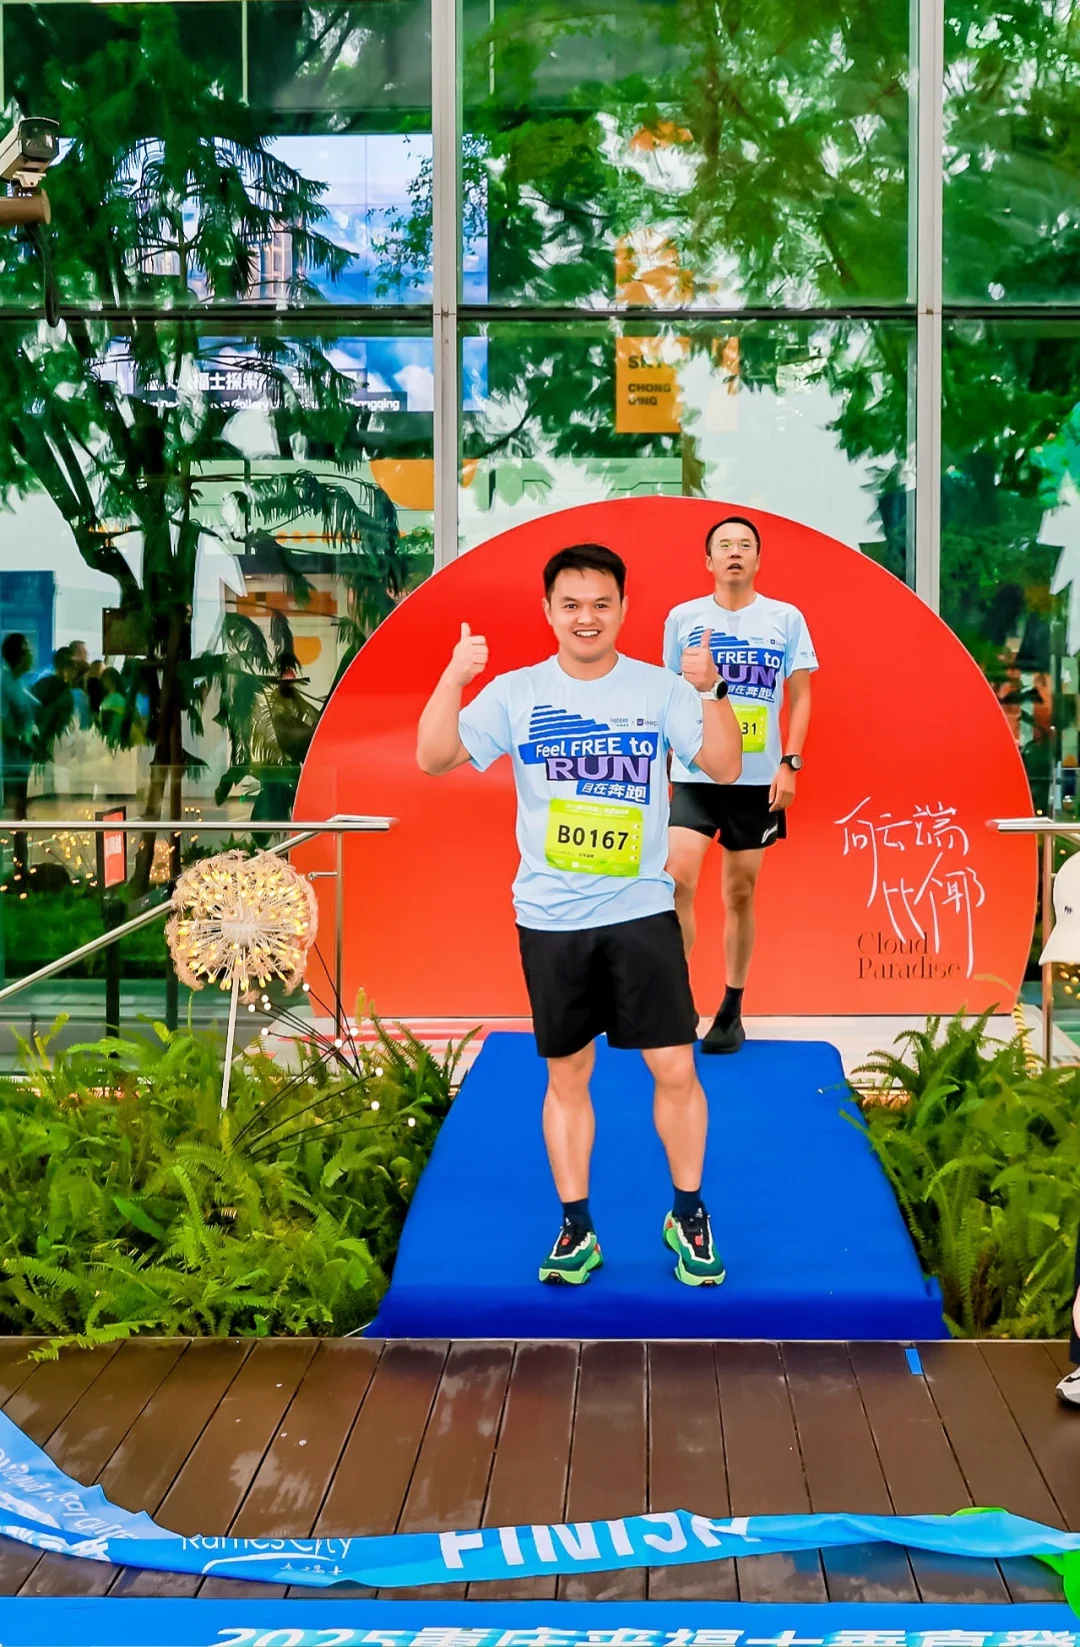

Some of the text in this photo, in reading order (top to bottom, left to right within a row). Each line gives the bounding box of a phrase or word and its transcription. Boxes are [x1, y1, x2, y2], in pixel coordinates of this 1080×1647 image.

[628, 383, 671, 392] CHONG
[717, 651, 780, 667] FREE to
[715, 664, 775, 687] UN
[536, 737, 653, 758] Feel FREE to
[547, 756, 649, 784] RUN
[557, 825, 629, 851] B0167
[857, 931, 928, 954] Cloud
[857, 956, 960, 979] Paradise
